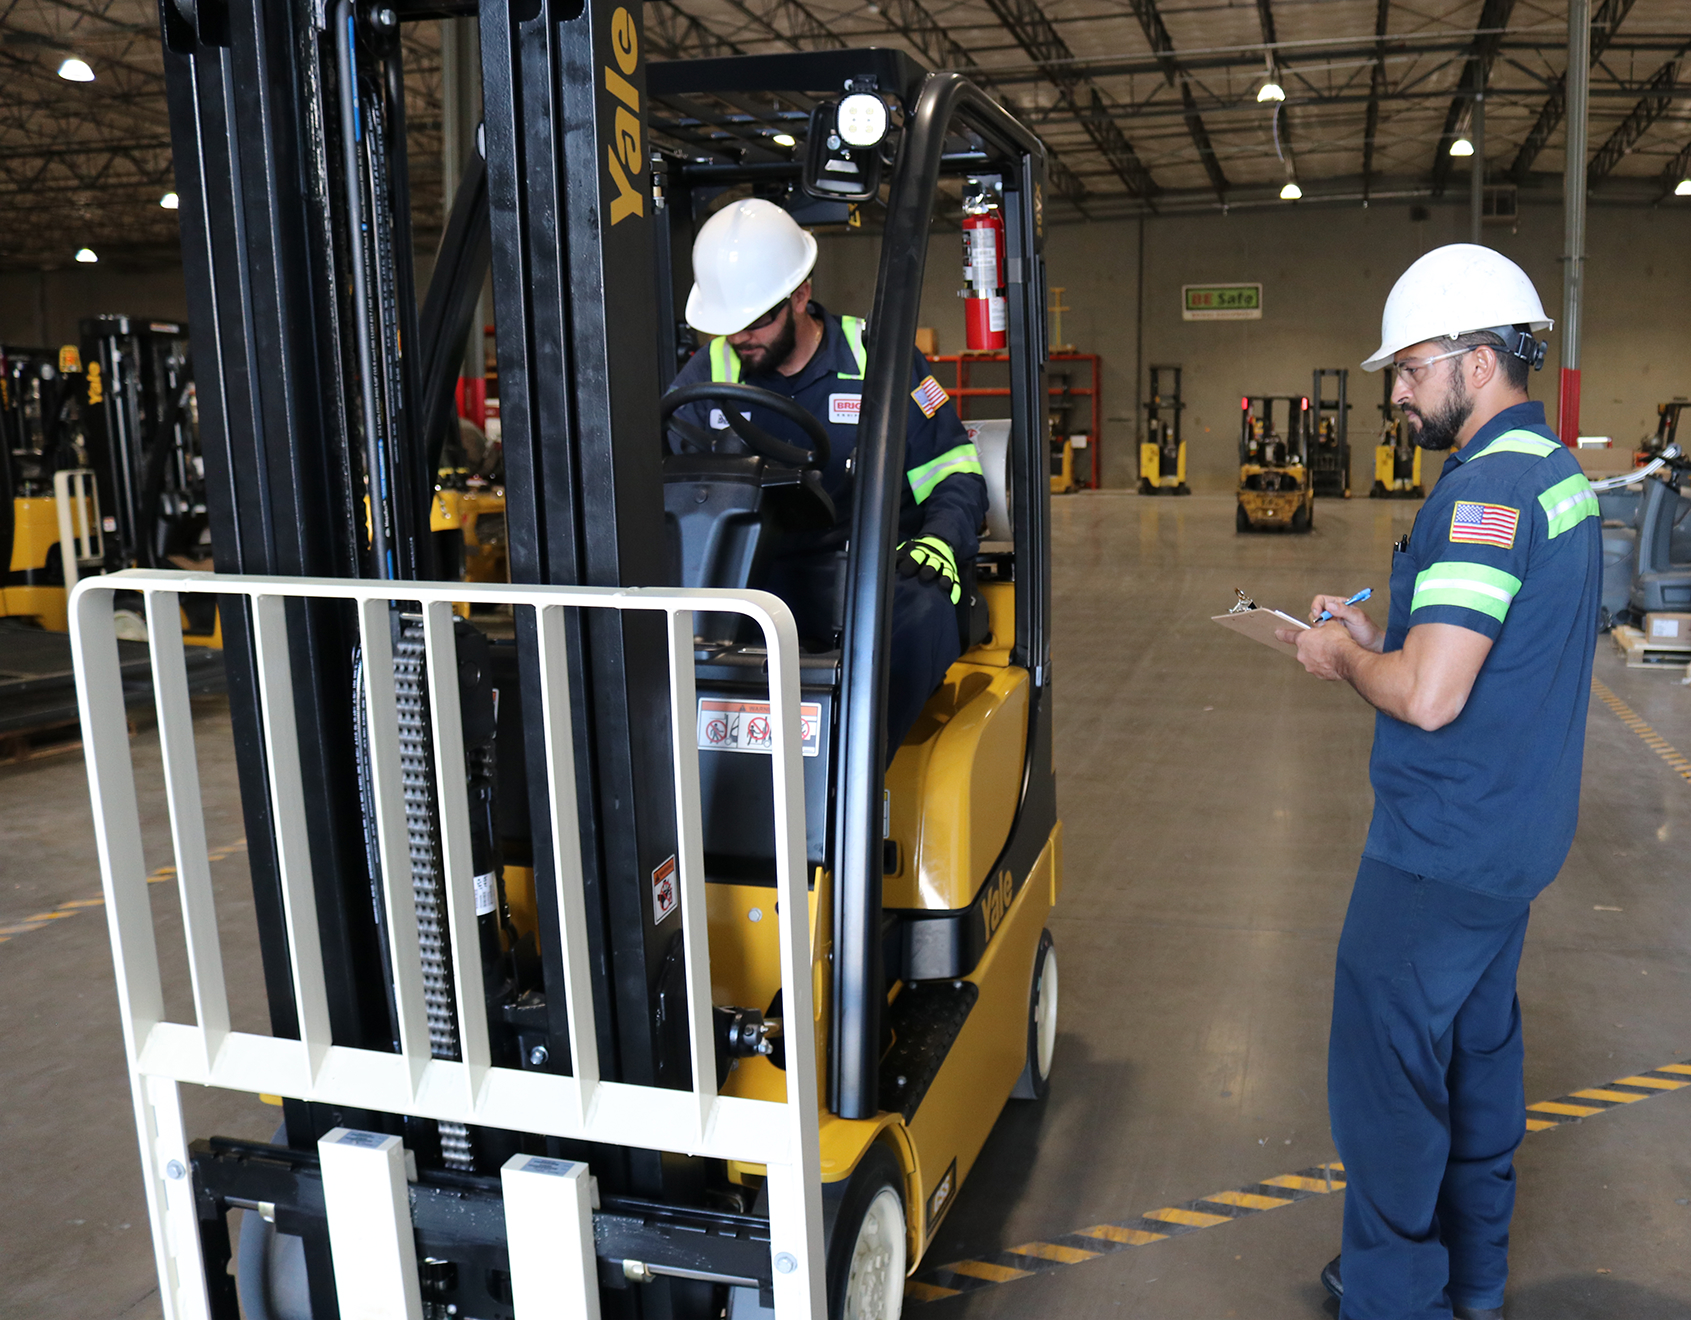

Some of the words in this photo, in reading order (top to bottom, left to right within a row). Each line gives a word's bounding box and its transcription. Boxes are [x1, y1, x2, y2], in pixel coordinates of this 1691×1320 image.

[605, 7, 644, 226] Yale
[1191, 292, 1213, 306] BE
[1218, 291, 1254, 305] Safe
[981, 870, 1013, 944] Yale
